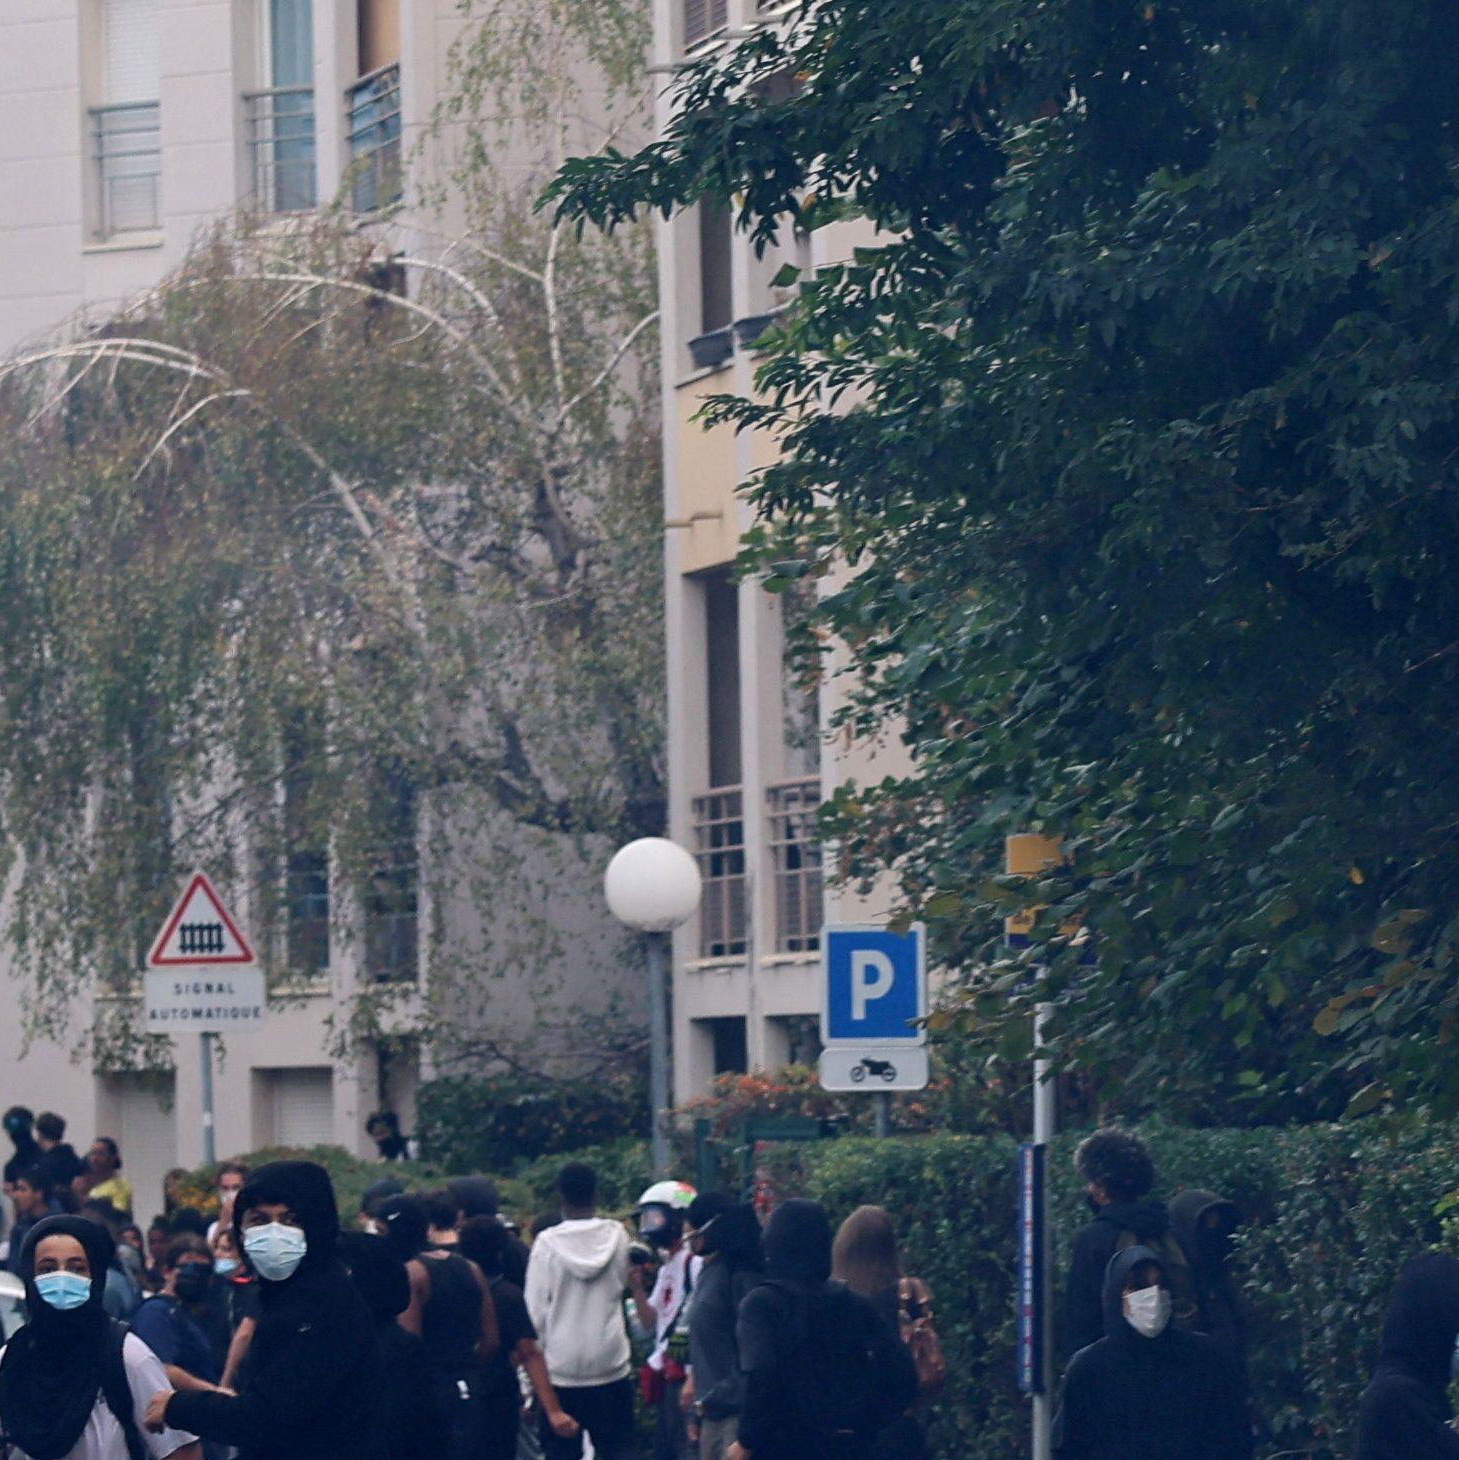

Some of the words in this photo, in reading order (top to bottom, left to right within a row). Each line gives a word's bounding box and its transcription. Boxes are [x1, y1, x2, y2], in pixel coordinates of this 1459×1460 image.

[174, 983, 235, 995] SIGNAL
[850, 949, 895, 1020] P
[149, 1006, 260, 1019] AUTOMATIQUE
